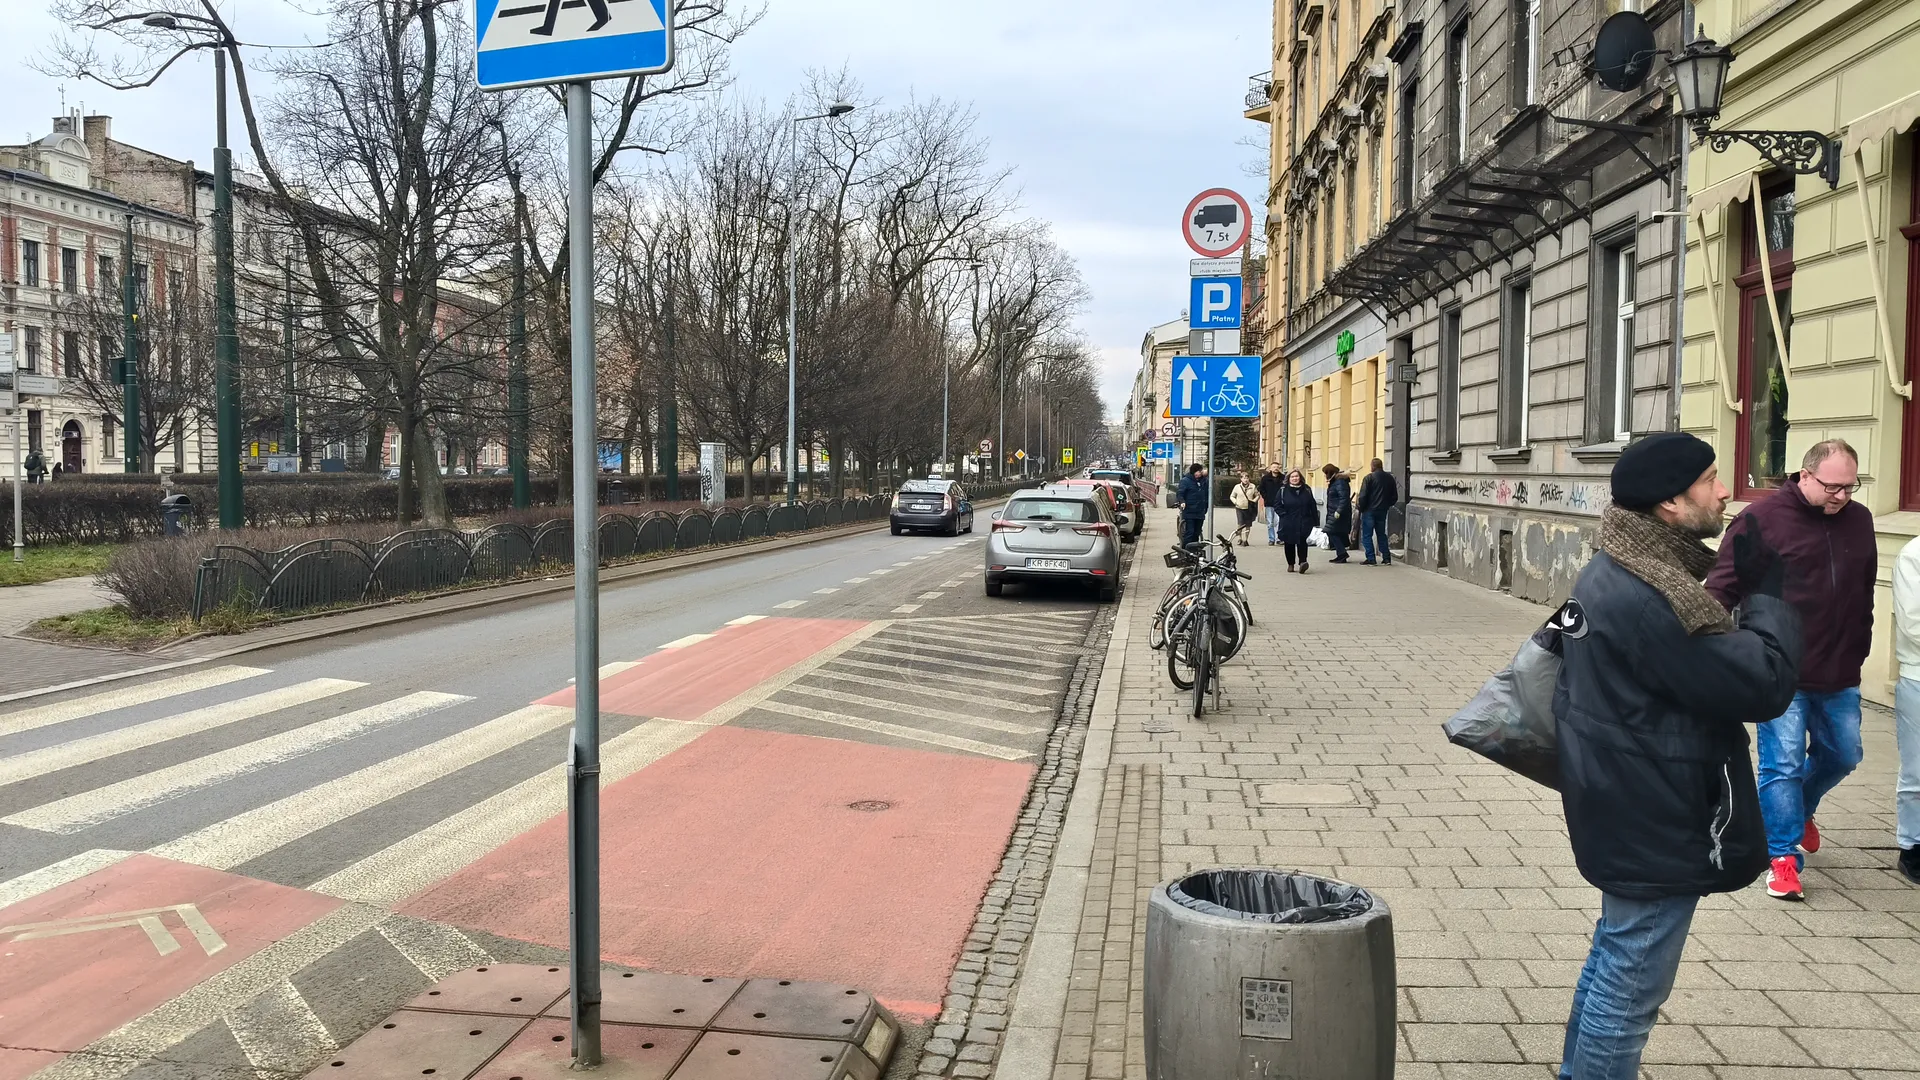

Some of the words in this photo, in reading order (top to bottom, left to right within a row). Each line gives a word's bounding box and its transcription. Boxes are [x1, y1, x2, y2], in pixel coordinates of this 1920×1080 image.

[1205, 230, 1230, 243] 7,5t
[1202, 283, 1231, 322] P
[1211, 315, 1235, 323] Płatny
